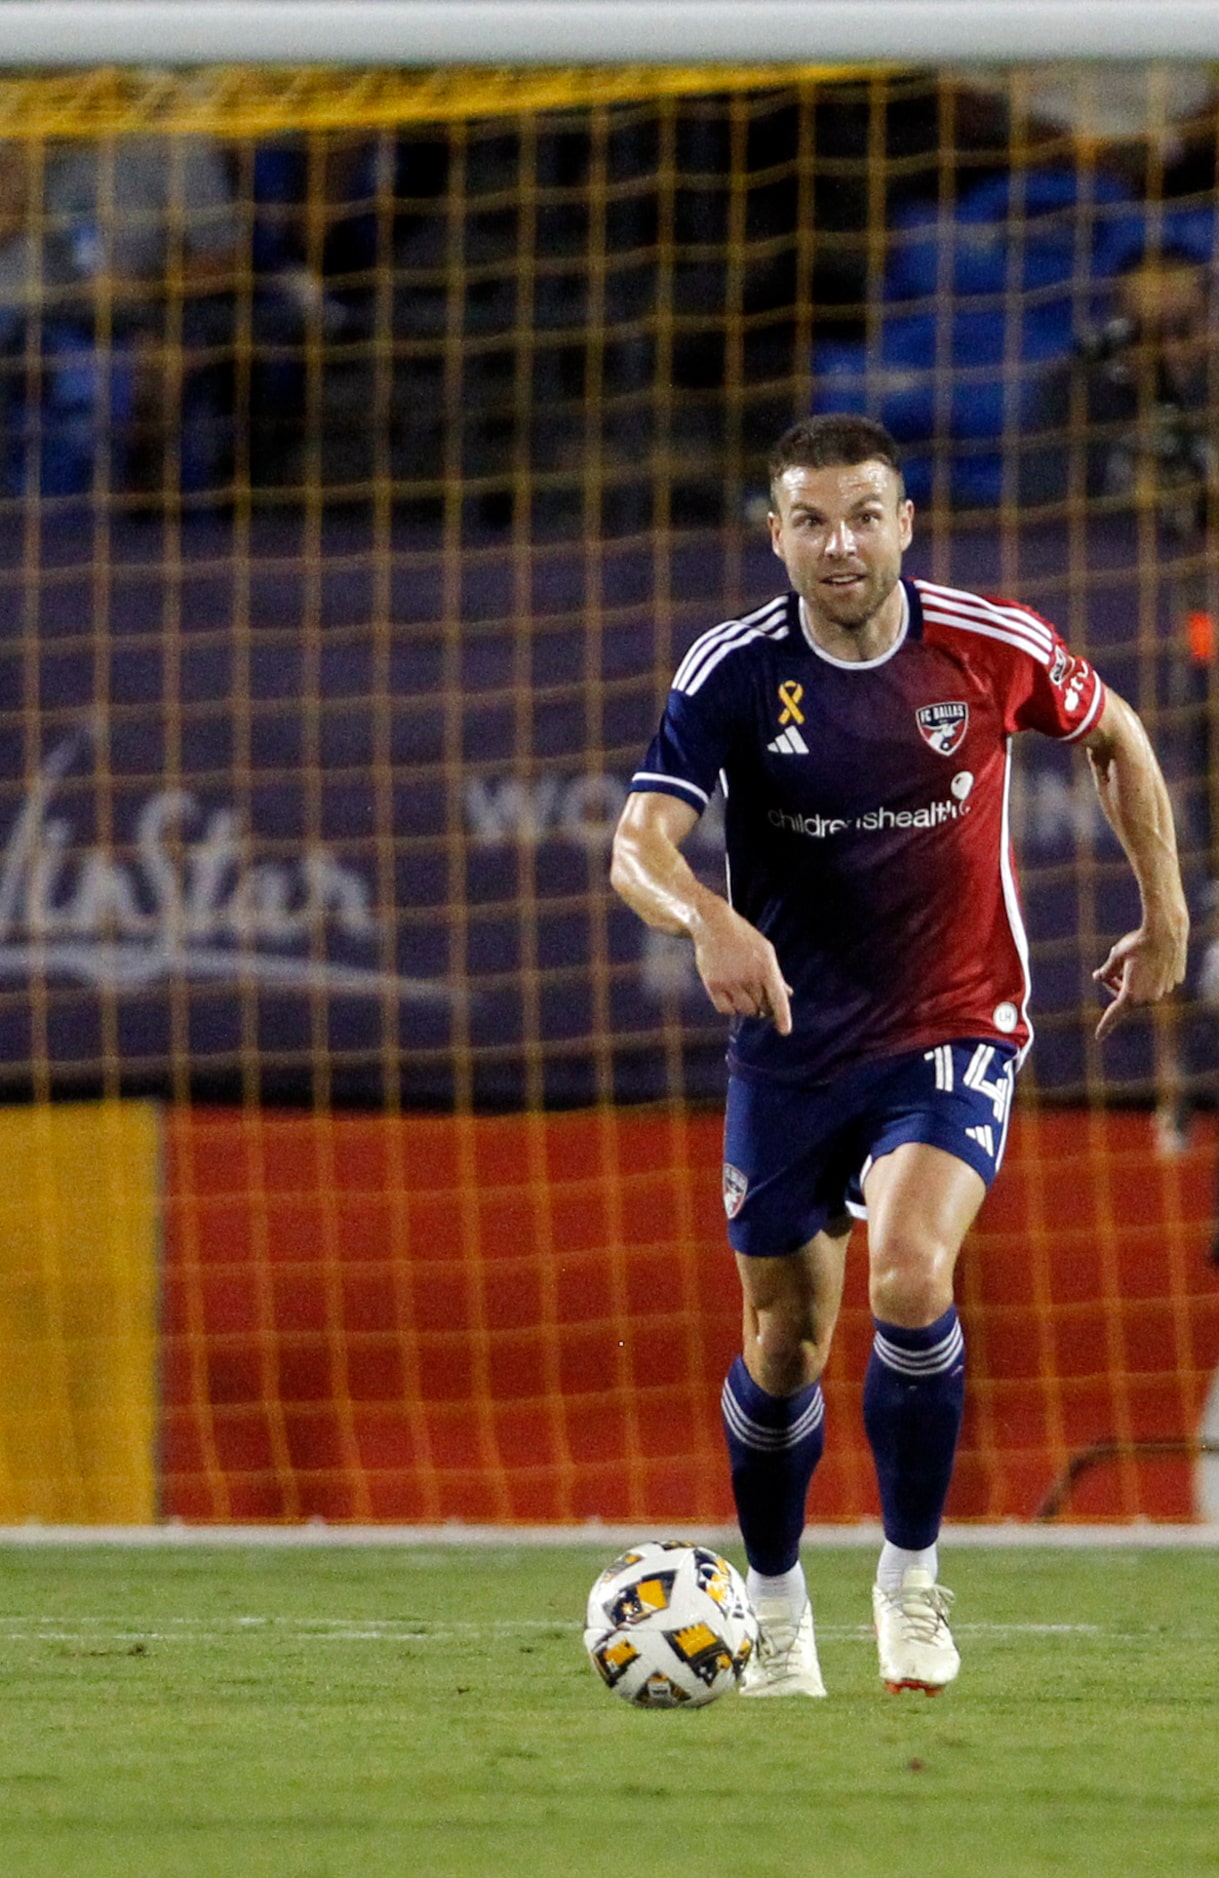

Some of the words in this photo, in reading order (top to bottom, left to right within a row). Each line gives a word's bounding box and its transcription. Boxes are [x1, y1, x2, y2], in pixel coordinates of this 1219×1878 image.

[920, 708, 932, 723] FC
[932, 704, 965, 720] DALLAS
[924, 1043, 1009, 1123] 14
